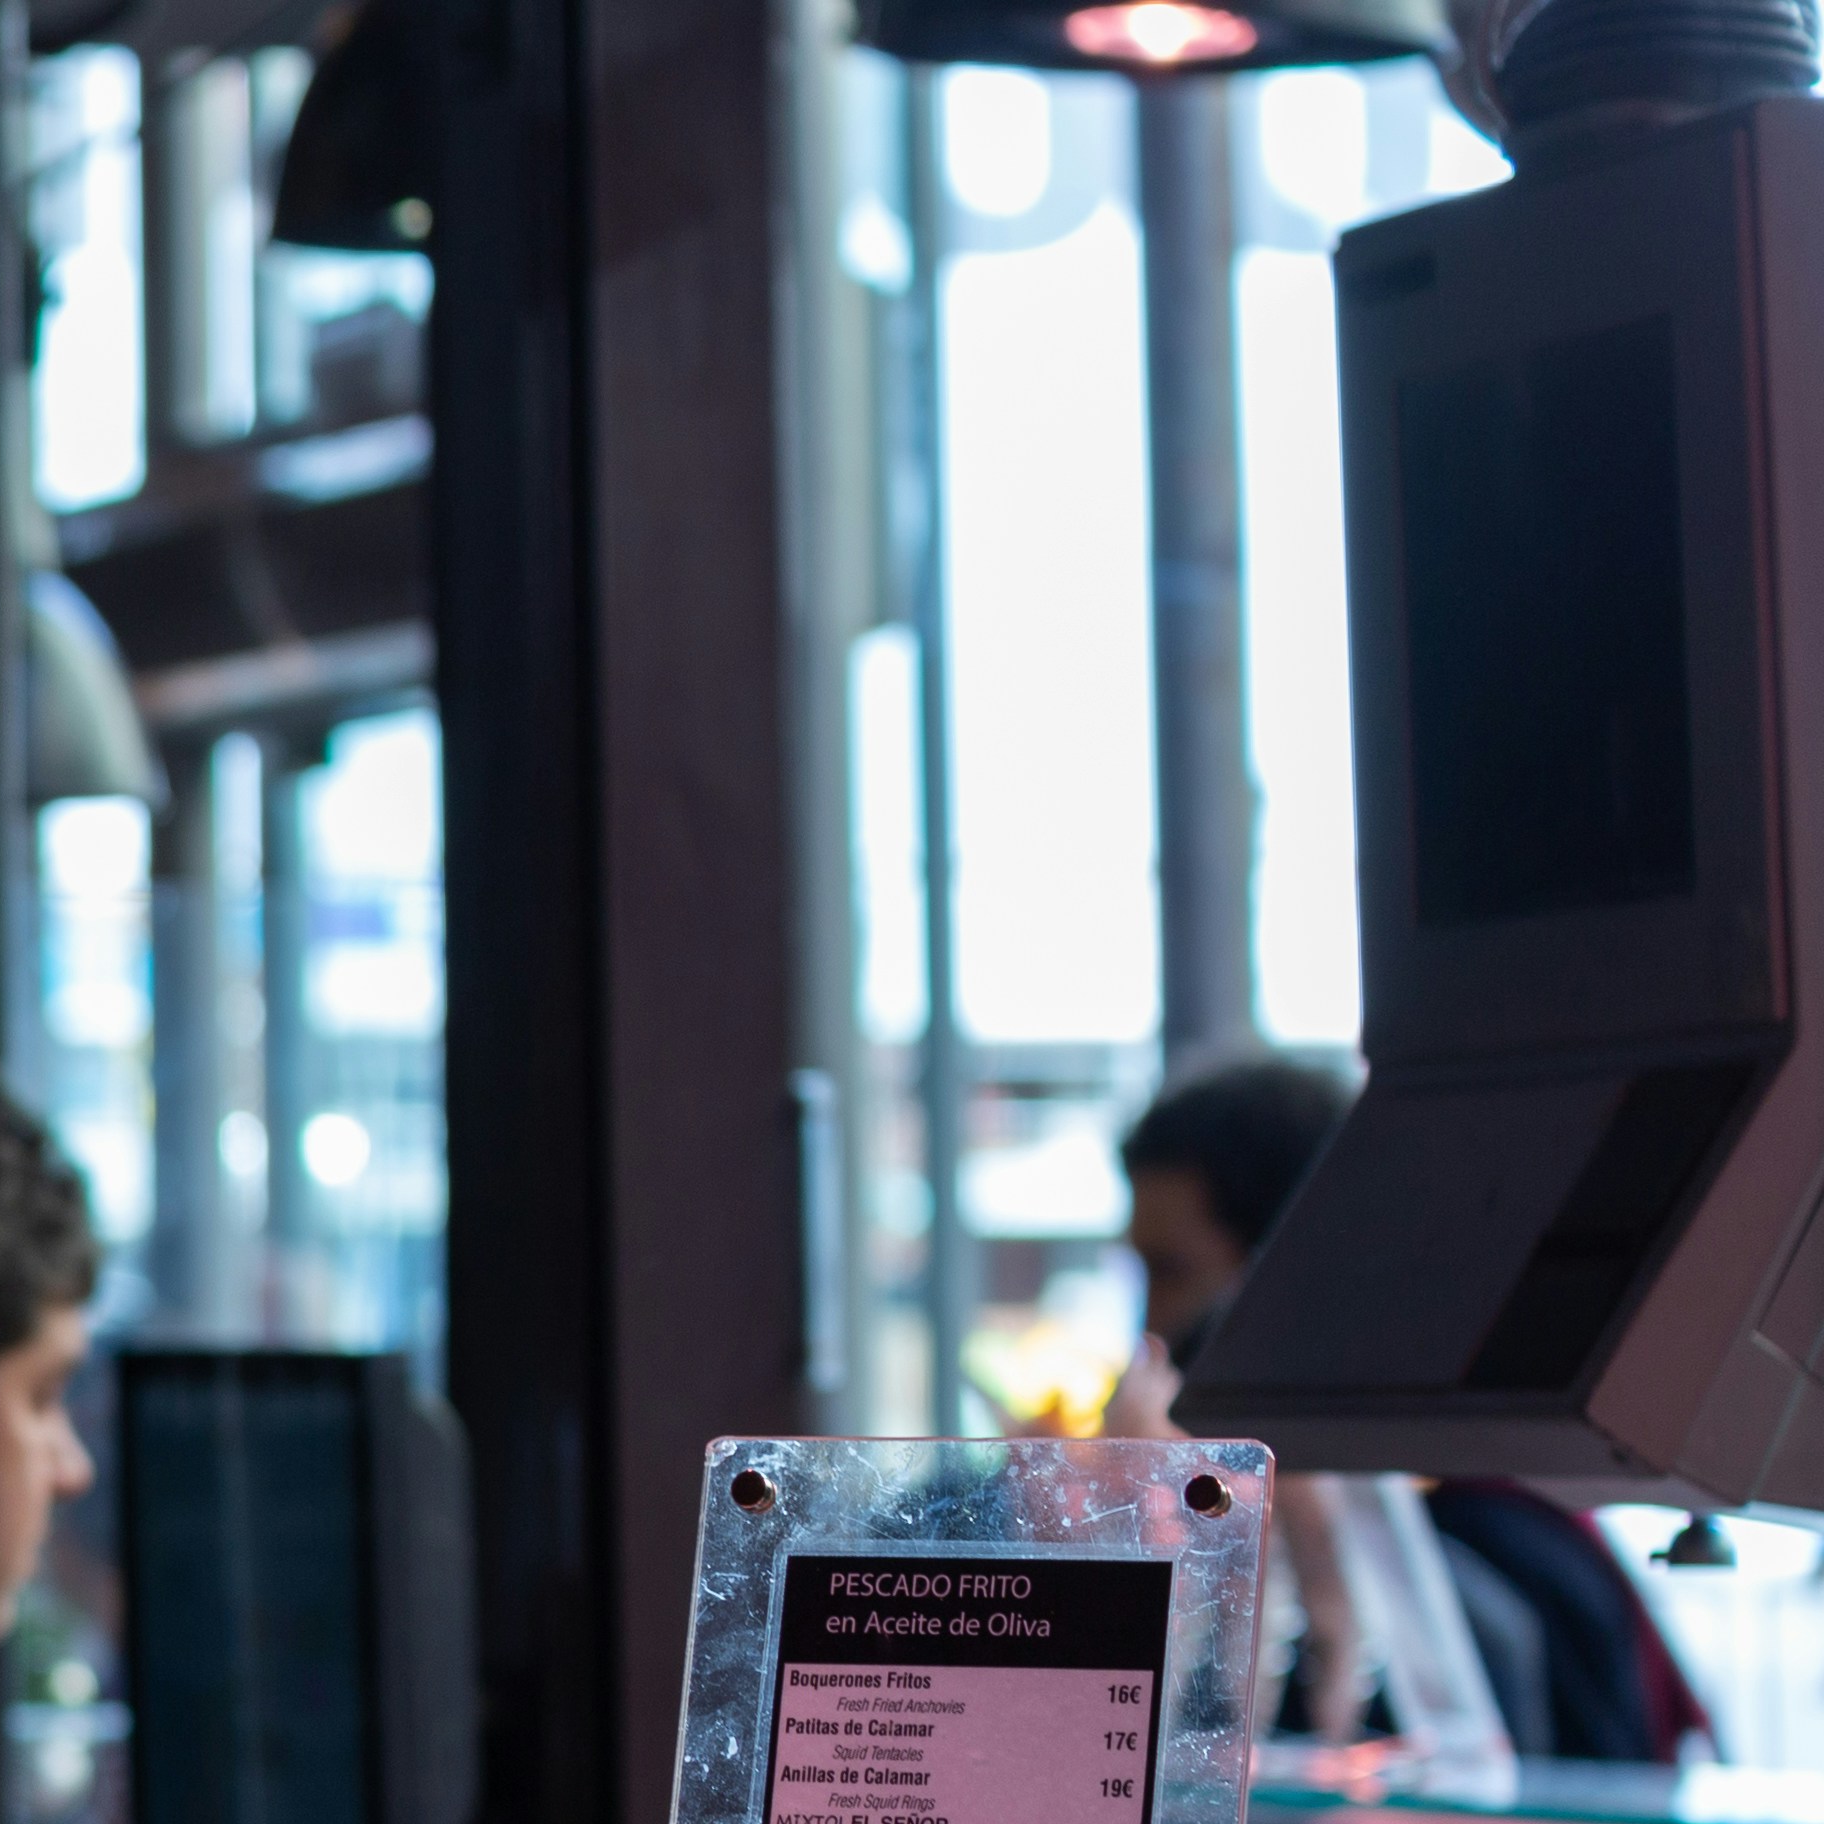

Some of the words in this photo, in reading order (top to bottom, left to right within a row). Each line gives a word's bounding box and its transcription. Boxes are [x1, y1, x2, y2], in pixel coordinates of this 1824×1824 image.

[830, 1573, 951, 1598] PESCADO
[959, 1575, 1032, 1599] FRITO
[826, 1616, 856, 1634] en
[864, 1611, 942, 1636] Aceite
[949, 1611, 981, 1636] de
[988, 1612, 1051, 1637] Oliva
[790, 1670, 881, 1691] Boquerones
[887, 1671, 932, 1689] Fritos
[1107, 1684, 1142, 1705] 16€
[837, 1697, 869, 1713] Fresh
[872, 1698, 901, 1713] Fried
[906, 1698, 965, 1715] Anchovies
[785, 1717, 839, 1736] Patitas
[844, 1719, 863, 1736] de
[868, 1720, 934, 1738] Calamar
[1104, 1731, 1138, 1751] 17€
[833, 1745, 865, 1762] Squid
[870, 1746, 923, 1762] Tentacles
[781, 1765, 835, 1784] Anillas
[840, 1767, 859, 1784] de
[864, 1768, 931, 1786] Calamar
[1100, 1779, 1134, 1798] 19€
[828, 1793, 861, 1809] Fresh
[864, 1794, 899, 1811] Squid
[901, 1795, 935, 1812] Rings
